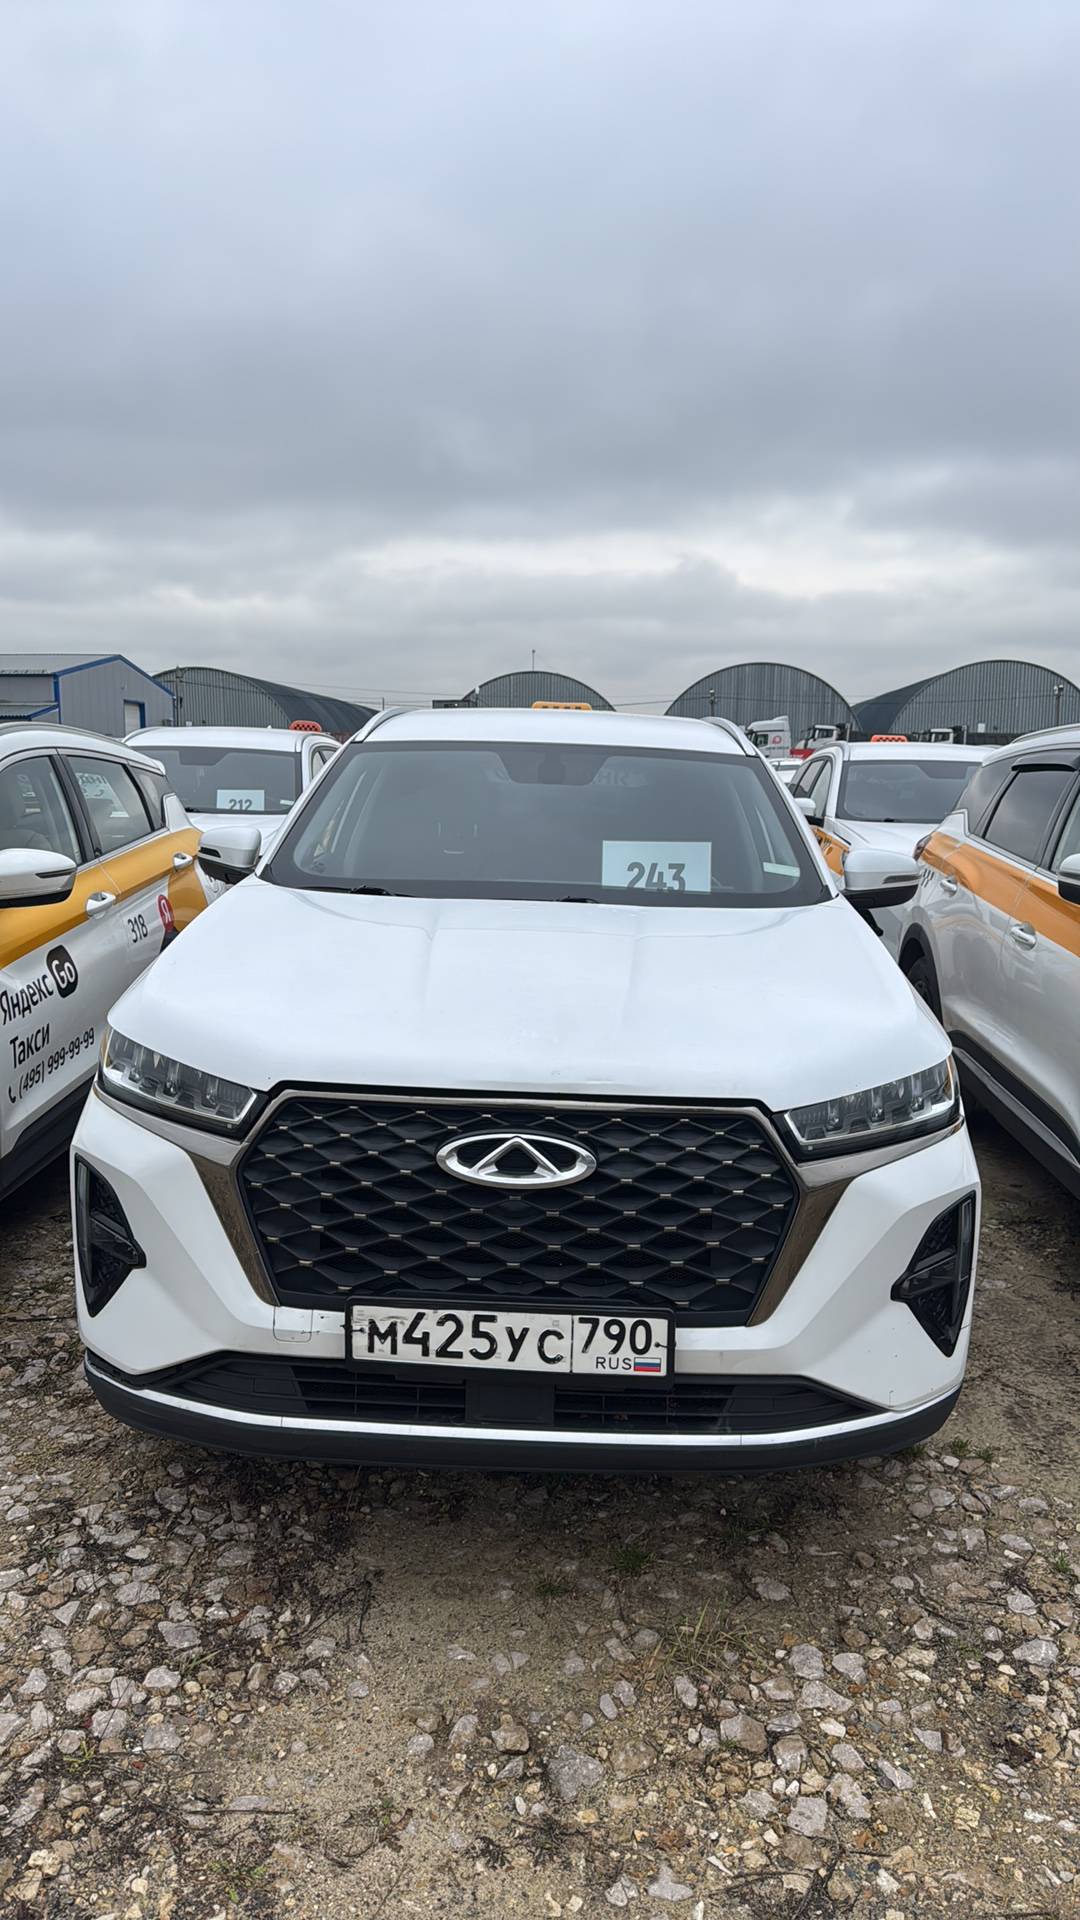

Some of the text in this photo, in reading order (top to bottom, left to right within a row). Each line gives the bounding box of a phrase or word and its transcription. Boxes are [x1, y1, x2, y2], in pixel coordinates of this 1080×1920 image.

[228, 798, 253, 811] 212
[626, 861, 687, 892] 243
[127, 914, 149, 943] 318
[0, 959, 76, 1026] Яндекс Go
[9, 1022, 50, 1070] Такси
[18, 1027, 95, 1099] (495) 999-99-99
[577, 1316, 652, 1355] 790
[595, 1356, 632, 1371] RUS
